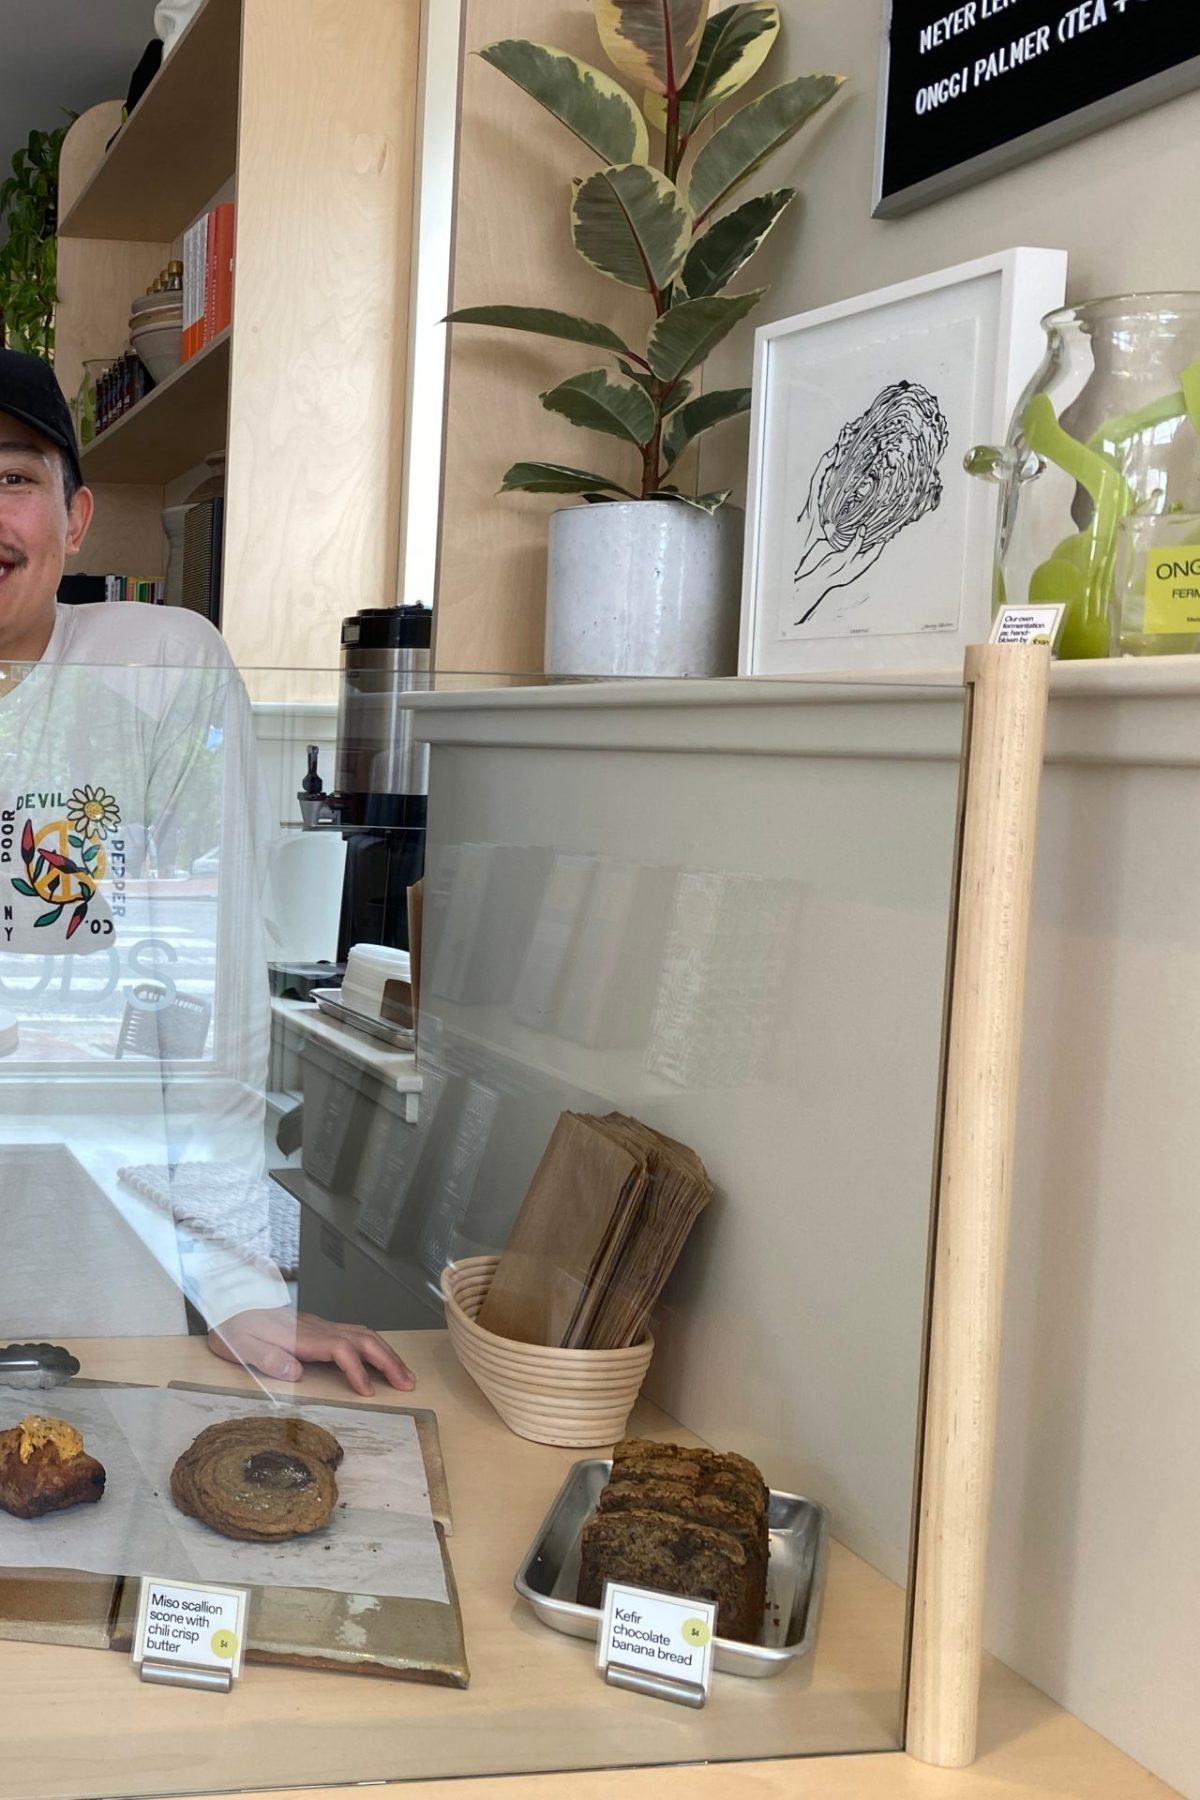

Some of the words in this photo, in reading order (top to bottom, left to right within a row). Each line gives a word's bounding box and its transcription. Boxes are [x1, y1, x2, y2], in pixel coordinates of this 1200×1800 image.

[919, 1, 977, 54] MEYER
[915, 67, 968, 115] ONGGI
[973, 25, 1050, 87] PALMER
[1057, 0, 1107, 43] (TEA
[1156, 558, 1200, 580] ONG
[16, 793, 66, 811] DEVIL
[1, 810, 15, 862] POOR
[111, 839, 125, 918] PEPPER
[85, 919, 113, 935] CO.
[151, 1593, 179, 1609] Miso
[181, 1600, 223, 1615] scallion
[149, 1610, 184, 1624] scone
[186, 1615, 210, 1628] with
[615, 1607, 642, 1624] Kefir
[146, 1636, 181, 1653] butter
[148, 1623, 170, 1637] chili
[171, 1627, 199, 1644] crisp
[613, 1624, 671, 1646] chocolate
[612, 1636, 655, 1657] banana
[657, 1647, 692, 1666] bread
